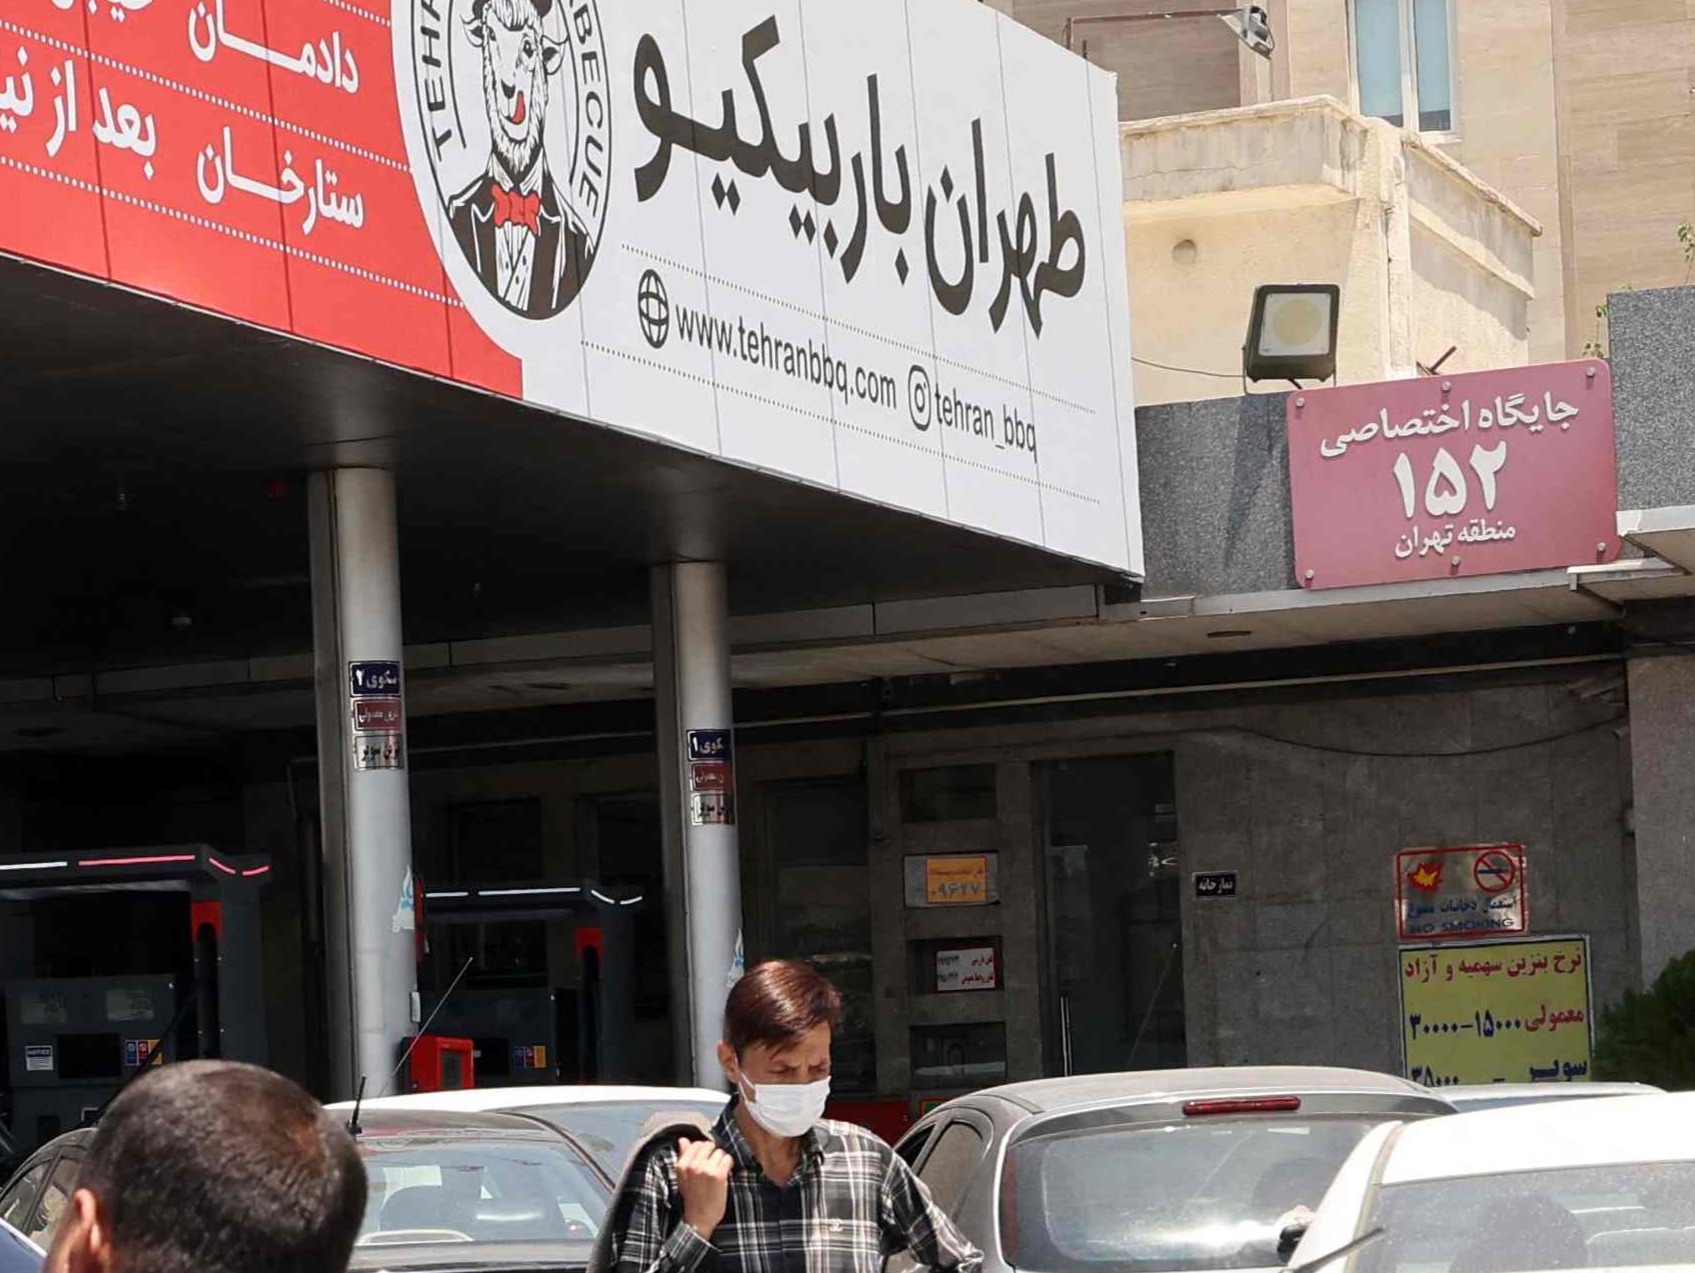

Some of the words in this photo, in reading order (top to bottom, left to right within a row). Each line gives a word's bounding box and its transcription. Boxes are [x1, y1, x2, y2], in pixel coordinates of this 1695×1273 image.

[188, 0, 359, 94] دادمان
[45, 60, 77, 157] از
[93, 87, 156, 181] بعد
[568, 0, 604, 218] BECUE
[196, 126, 364, 236] ستارخان
[924, 118, 1088, 340] طهران
[675, 303, 898, 410] www.tehranbbq.com
[934, 384, 1039, 465] tehran_bbq
[1478, 391, 1580, 433] جایگاه
[1319, 399, 1471, 458] اختصاصی
[1393, 440, 1508, 519] ۱۵۲
[1394, 522, 1454, 558] تهران
[1457, 518, 1516, 545] منطقه
[1405, 954, 1439, 983] آزاد
[1445, 962, 1454, 981] و
[1507, 952, 1549, 978] بنزین
[1524, 1004, 1585, 1032] معمولی
